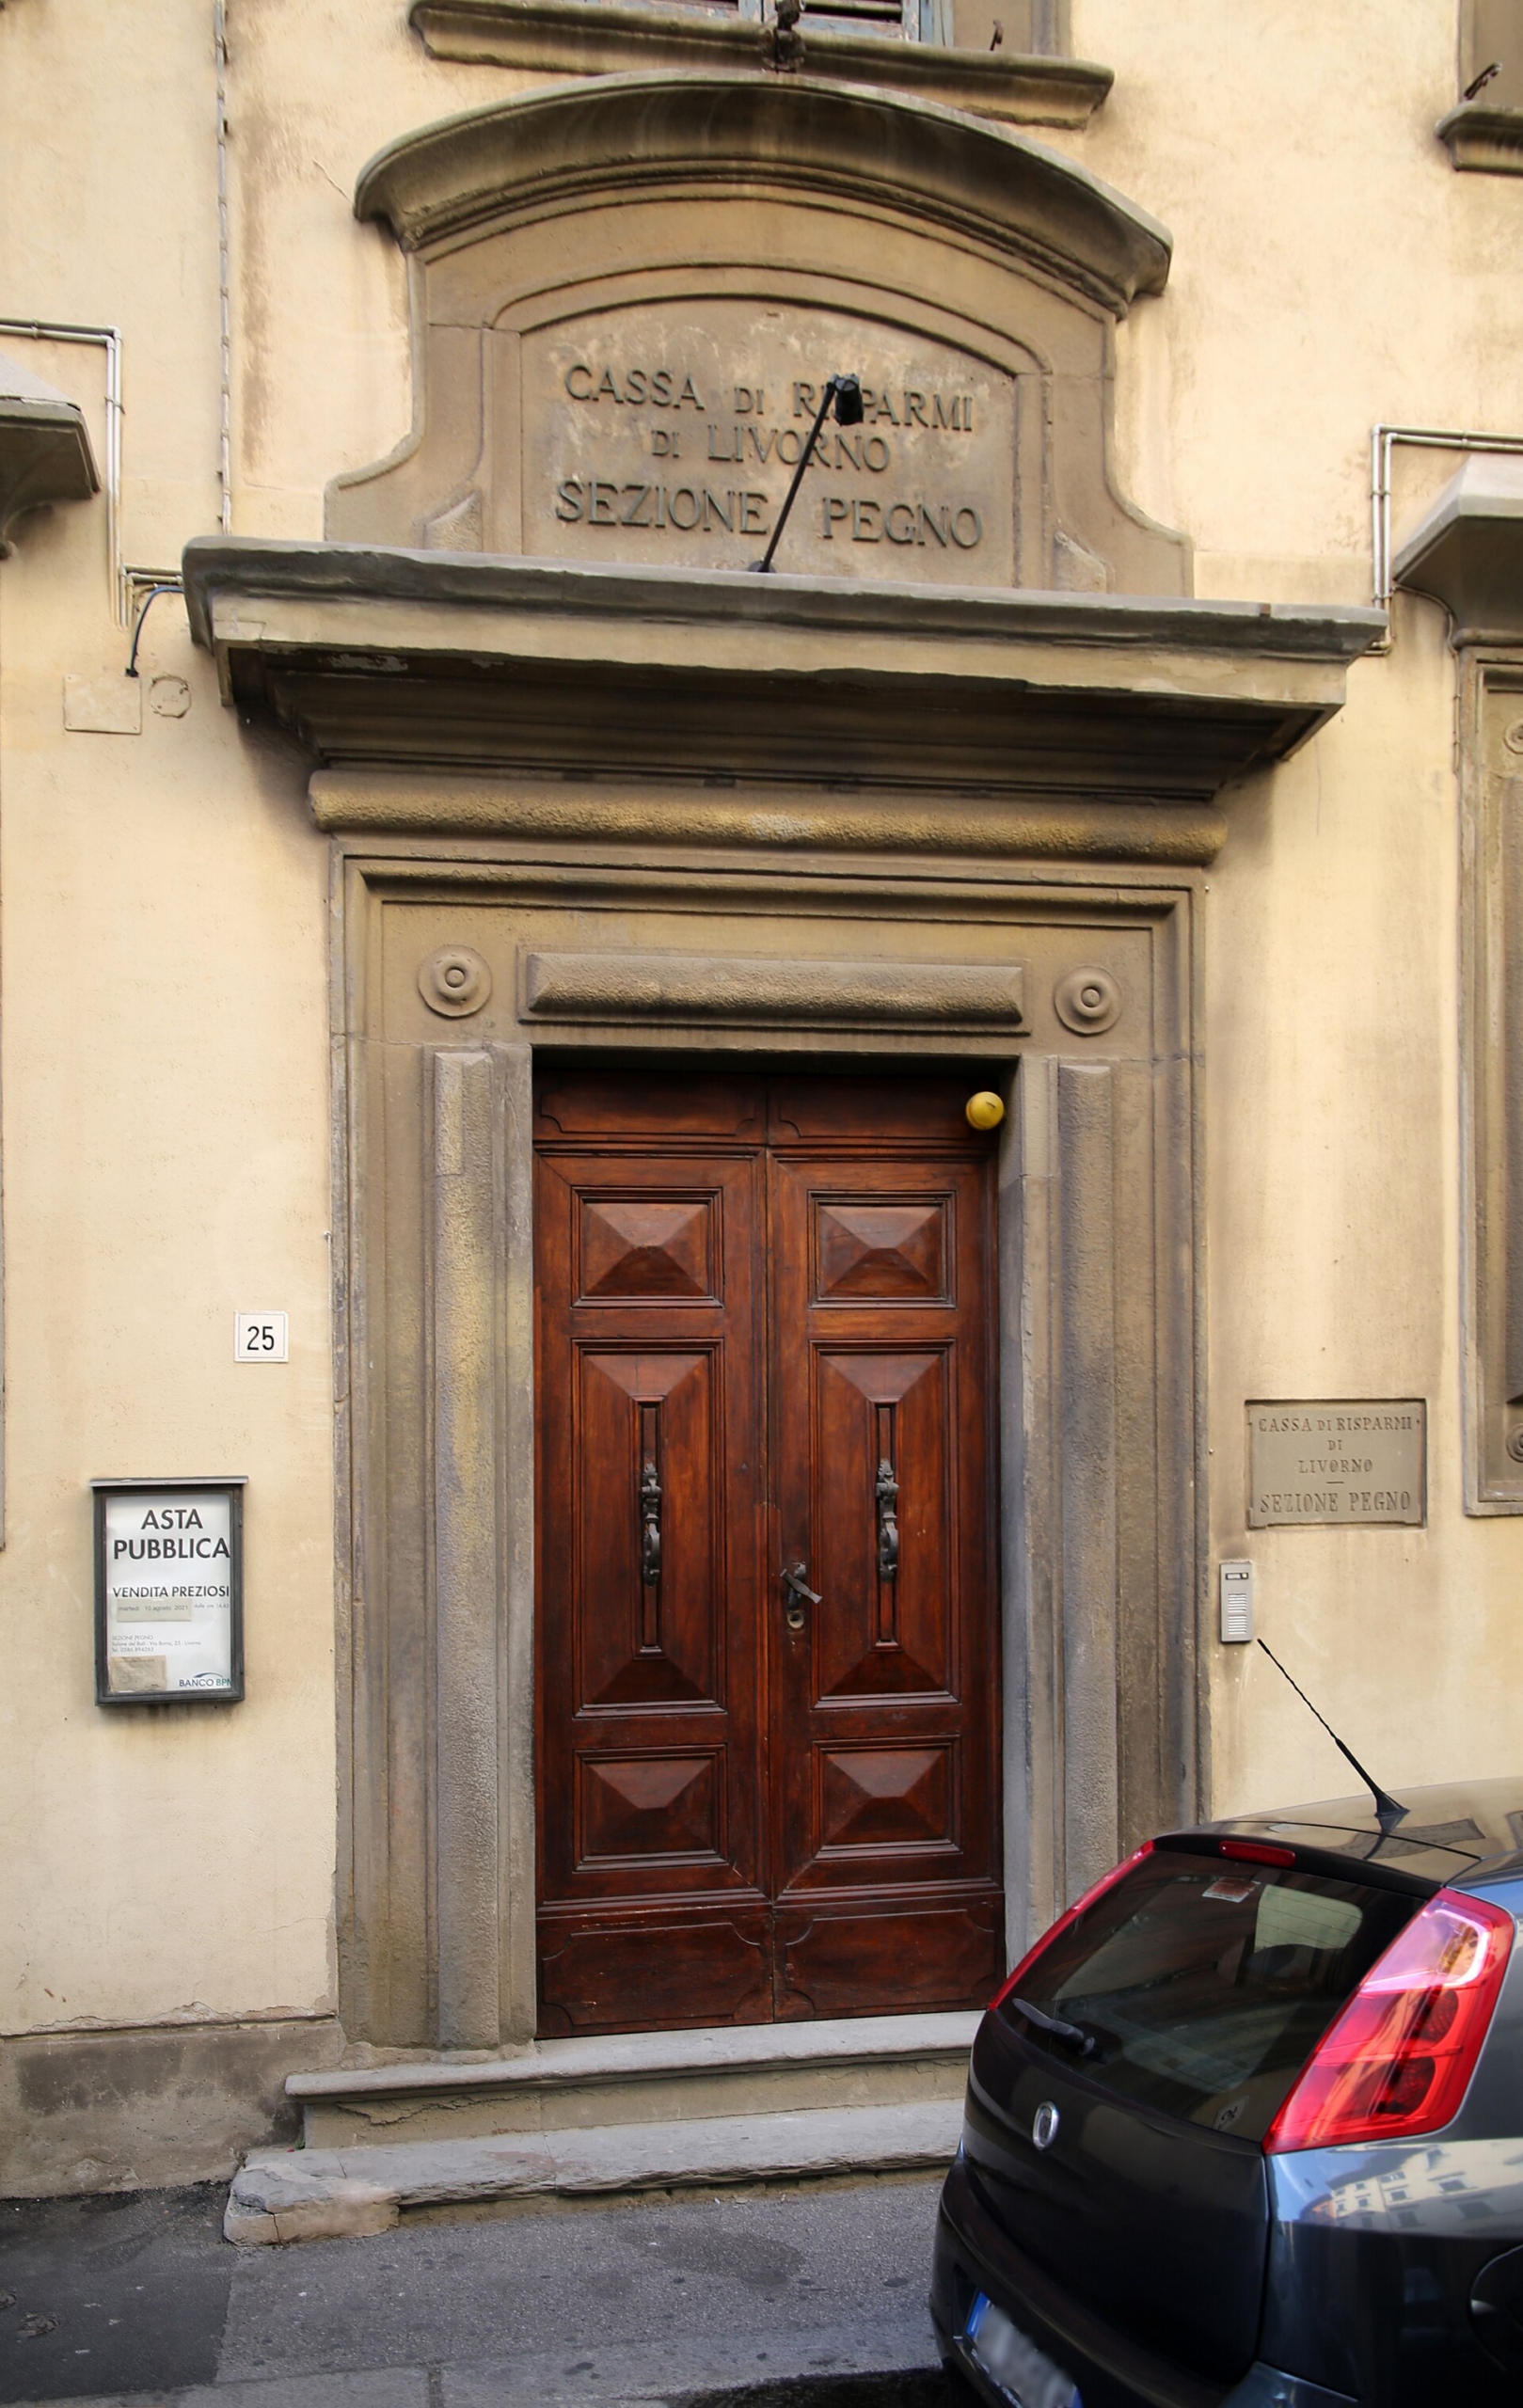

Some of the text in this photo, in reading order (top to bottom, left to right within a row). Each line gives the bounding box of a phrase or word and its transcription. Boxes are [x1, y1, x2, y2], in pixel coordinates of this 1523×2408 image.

[564, 363, 706, 412] CASSA
[733, 385, 765, 416] DI
[651, 423, 891, 472] DI LIVORNO
[555, 479, 982, 550] SEZIONE PEGNO
[247, 1325, 275, 1351] 25
[1259, 1417, 1412, 1433] CASSA DI RISPARMI
[1328, 1439, 1342, 1451] DI
[1298, 1459, 1372, 1474] LIVORNO
[1260, 1491, 1411, 1513] SEZIONE PEGNO
[141, 1509, 203, 1530] ASTA
[113, 1537, 230, 1560] PUBBLICA
[113, 1585, 230, 1598] VENDITA PREZIOSI
[179, 1678, 214, 1687] BANCO
